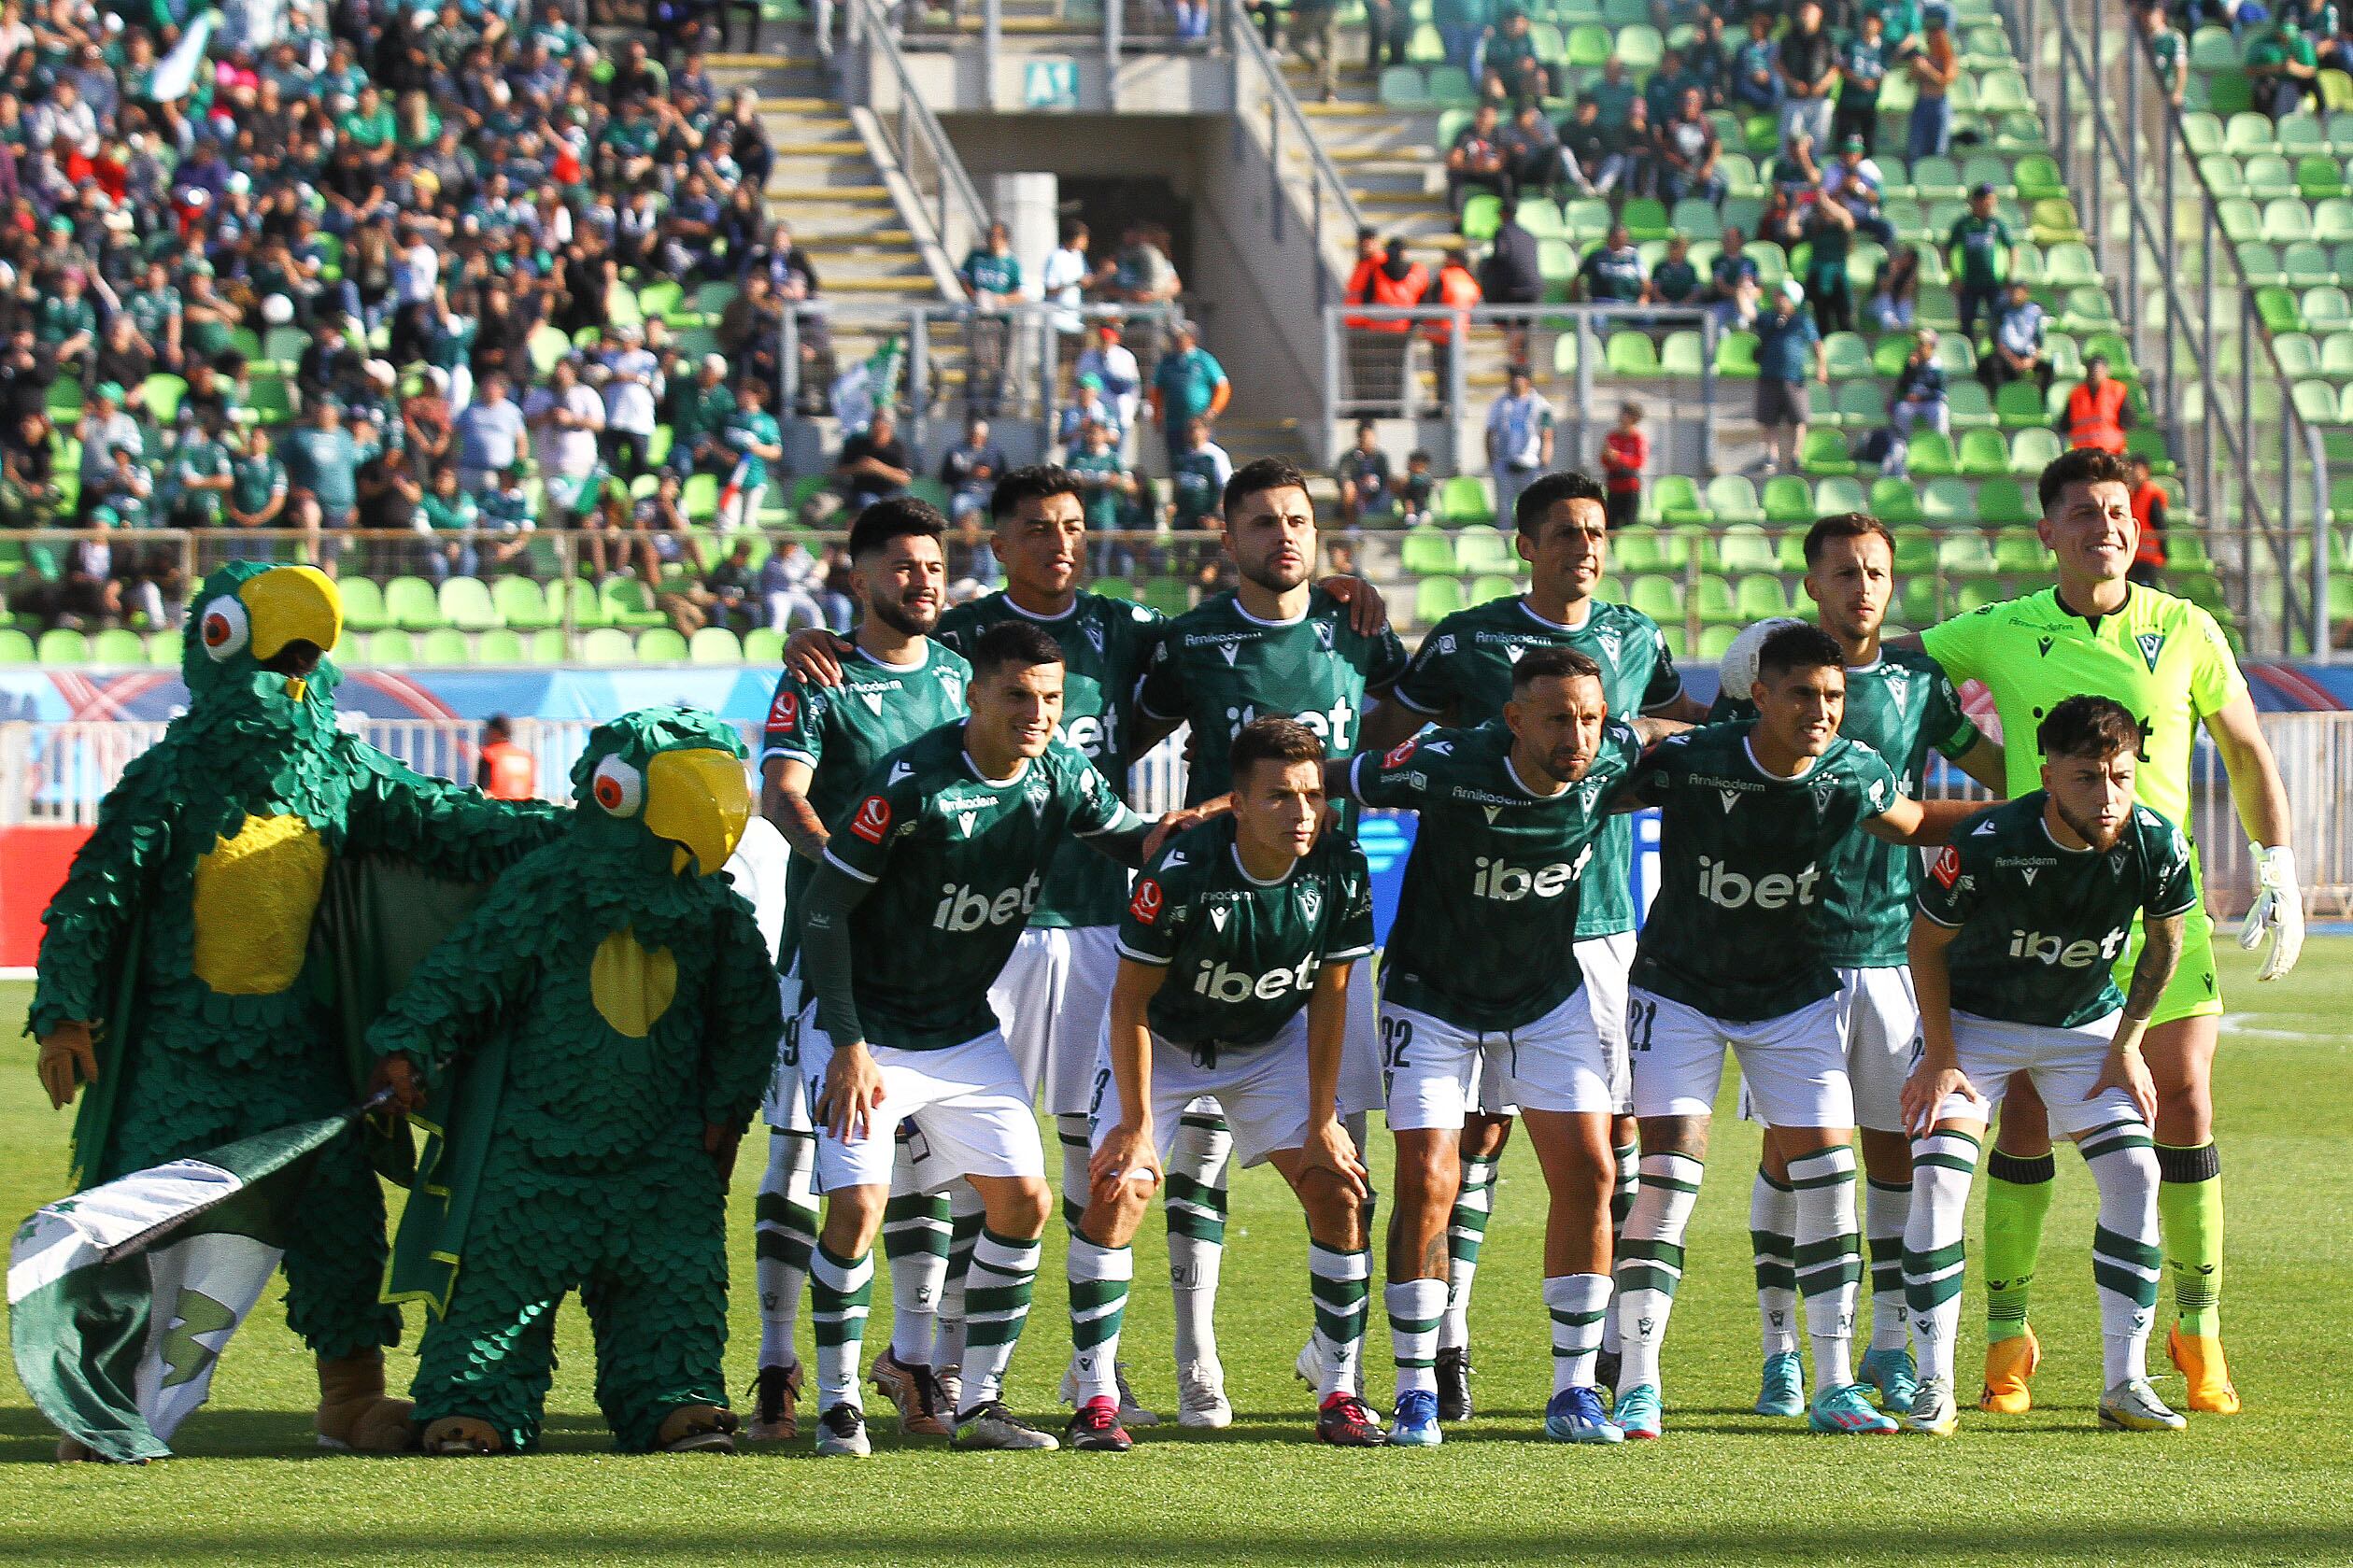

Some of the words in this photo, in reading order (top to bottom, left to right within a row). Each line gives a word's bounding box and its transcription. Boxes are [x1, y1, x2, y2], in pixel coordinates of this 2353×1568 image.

[1055, 701, 1118, 758] et
[1226, 695, 1352, 751] iet
[2033, 706, 2153, 763] it
[1473, 842, 1593, 901] ibet
[1698, 855, 1821, 909] ibet
[932, 868, 1040, 932] ibet
[2009, 926, 2126, 968] ibet
[1194, 951, 1321, 1003] ibet
[1382, 1015, 1412, 1067] 32
[1629, 998, 1657, 1052] 21
